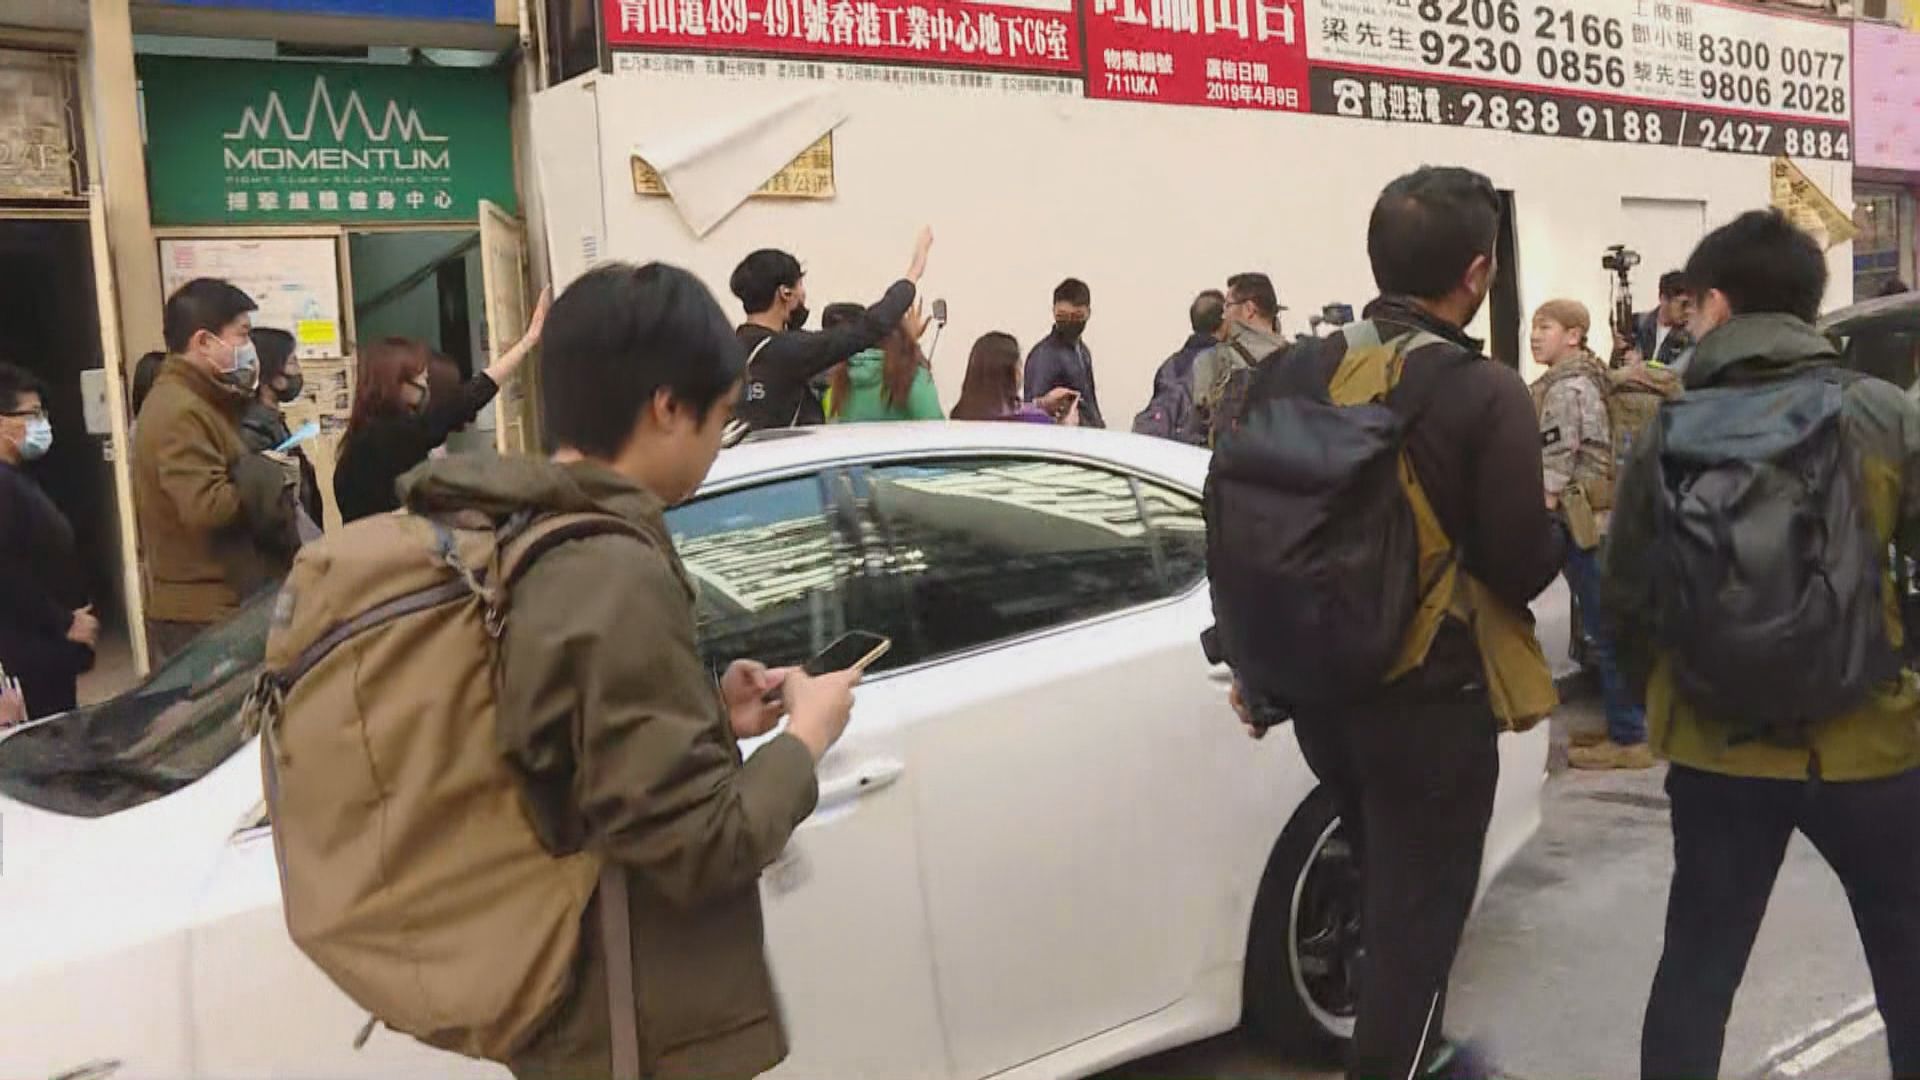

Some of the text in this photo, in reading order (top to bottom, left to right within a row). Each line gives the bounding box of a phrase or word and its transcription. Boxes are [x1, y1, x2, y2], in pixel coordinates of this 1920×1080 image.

[1418, 0, 1520, 34] 8206
[1534, 6, 1623, 50] 2166
[1206, 58, 1268, 84] 廣告日期
[1322, 17, 1414, 50] 梁先生
[1420, 30, 1522, 75] 9230
[1537, 46, 1625, 88] 0856
[1700, 34, 1770, 71] 8300
[1781, 46, 1844, 81] 0077
[1104, 73, 1158, 95] 711UKA
[1206, 82, 1299, 108] 2019年4月9日
[1700, 70, 1771, 106] 9806
[1782, 80, 1846, 114] 2028
[1461, 92, 1560, 134] 2838
[1576, 105, 1663, 143] 9188
[1699, 118, 1772, 153] 2427
[1785, 128, 1849, 160] 8884
[223, 147, 450, 169] MOMENTUM
